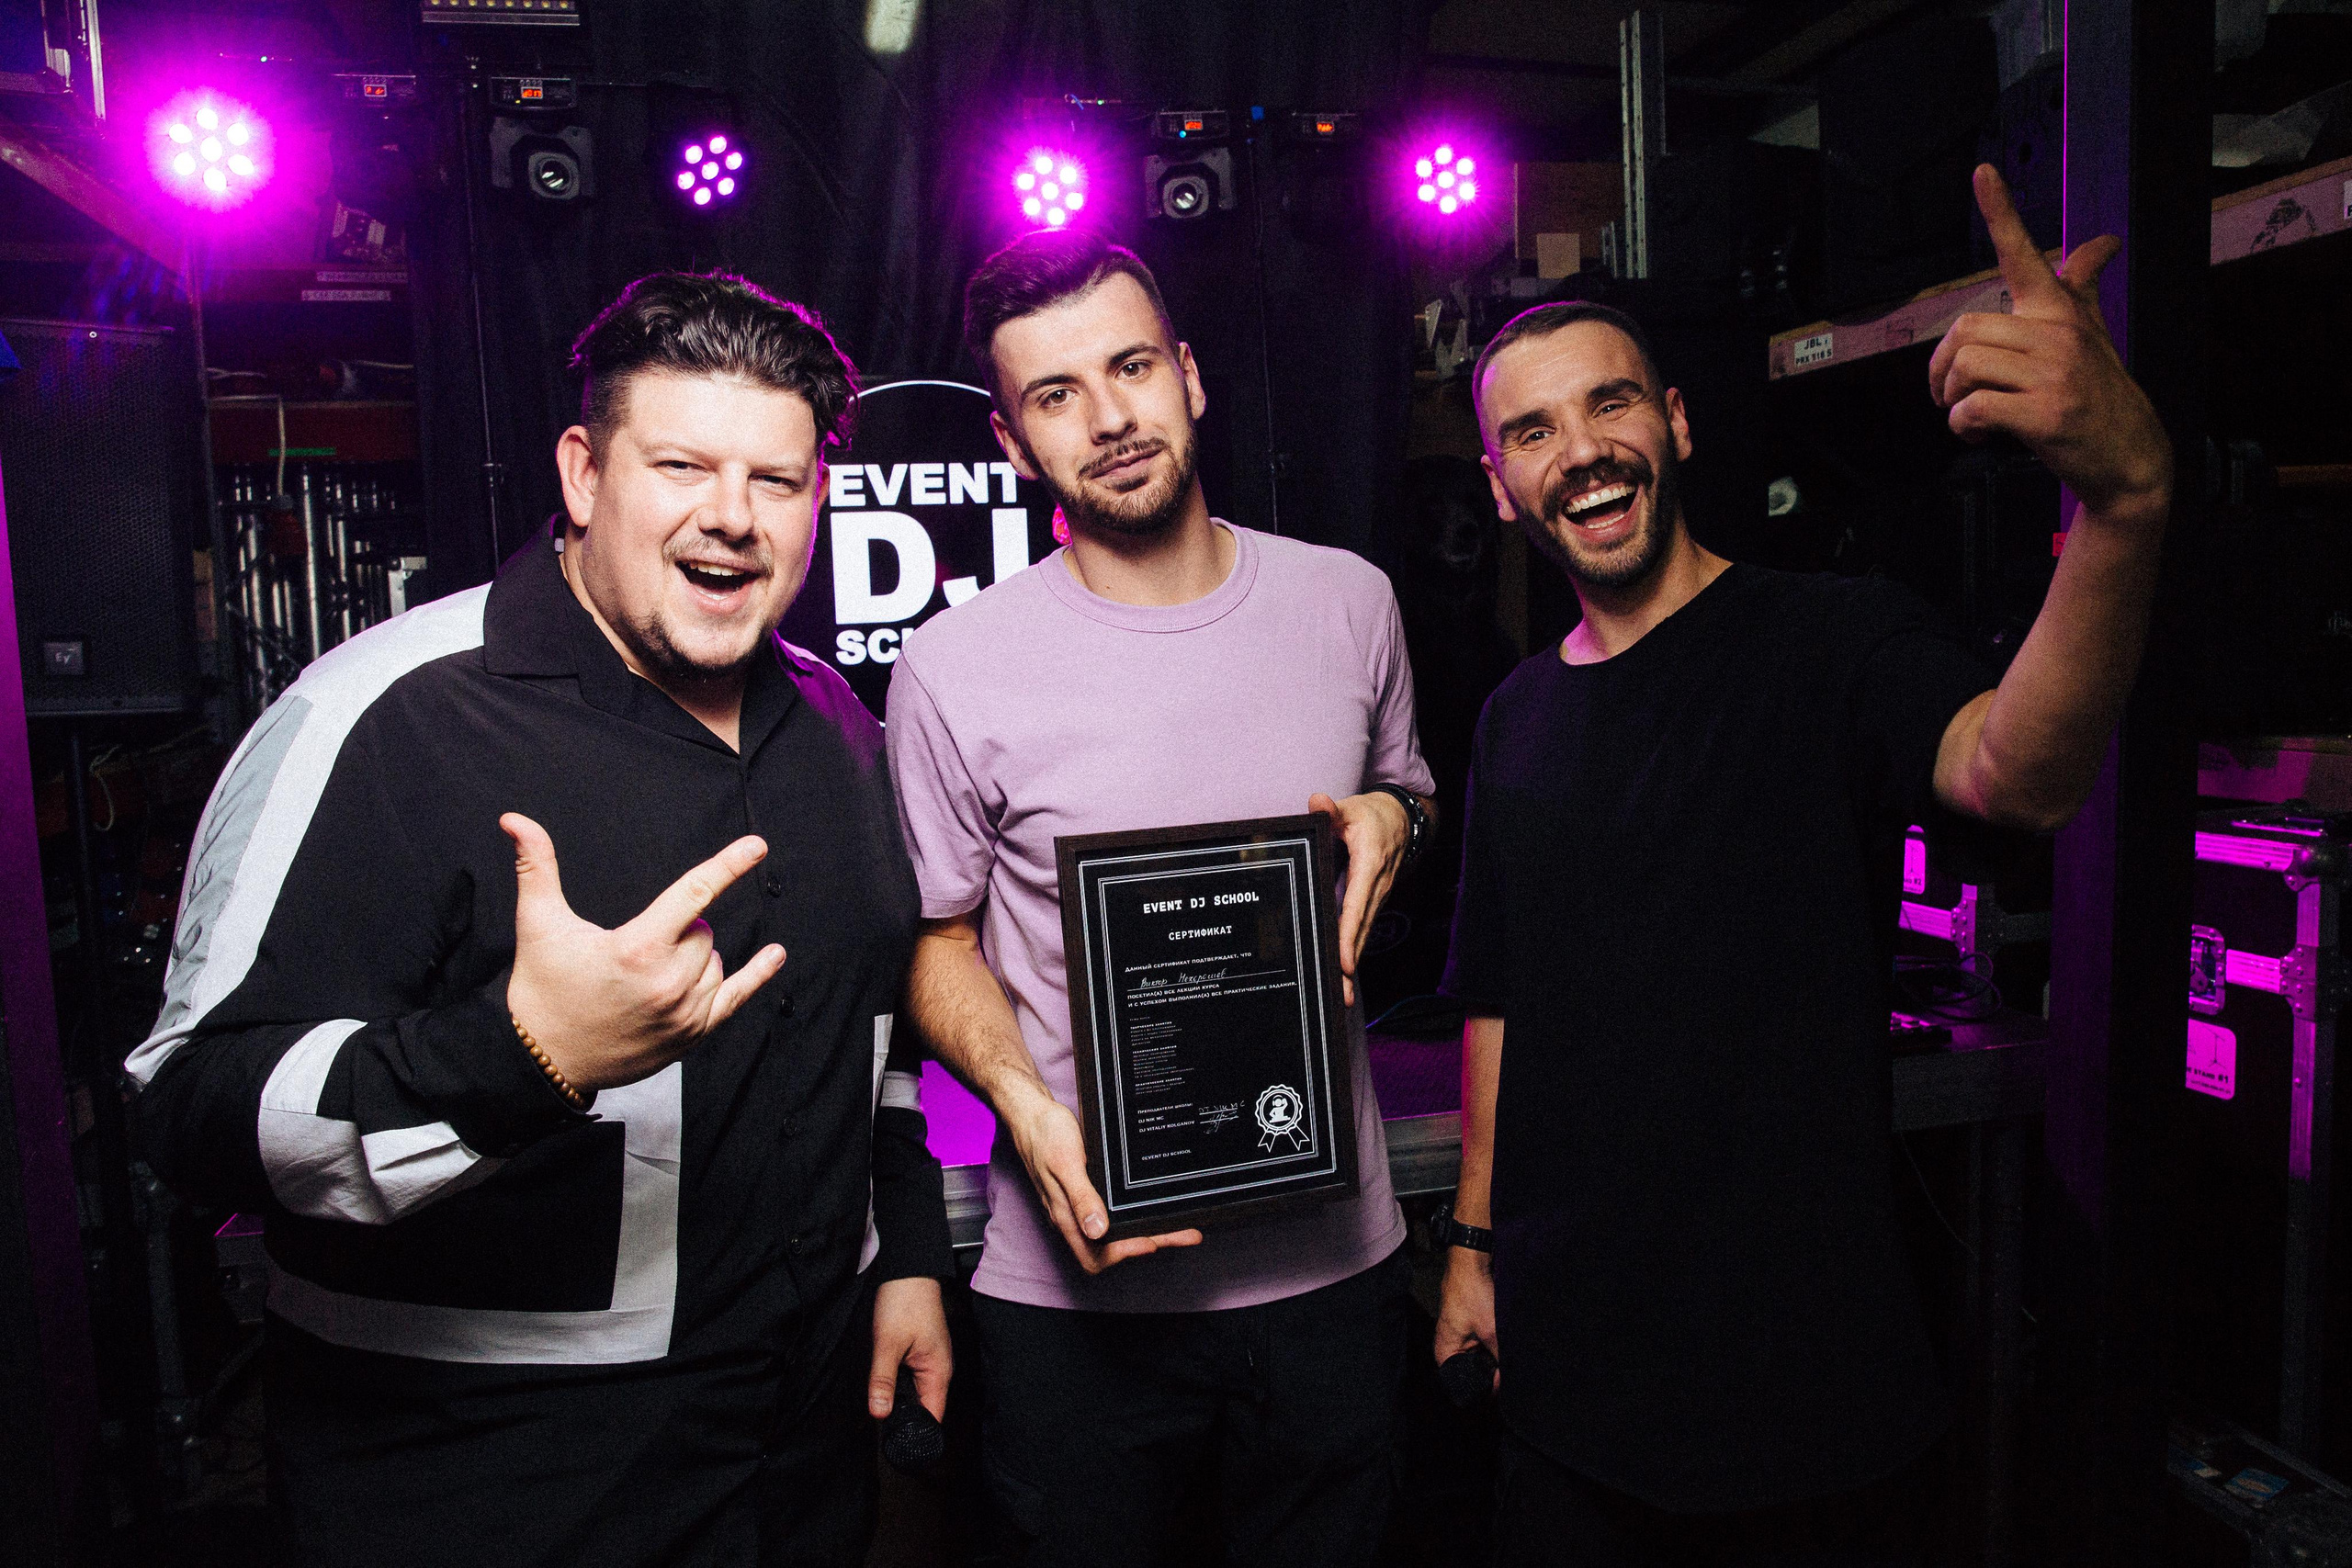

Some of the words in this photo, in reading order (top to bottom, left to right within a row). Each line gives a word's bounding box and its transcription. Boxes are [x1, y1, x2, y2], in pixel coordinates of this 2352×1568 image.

[1804, 337, 1822, 350] JBL
[829, 461, 1018, 507] EVENT
[830, 507, 1030, 626] DJ
[835, 627, 914, 666] SC
[1143, 899, 1182, 914] EVENT
[1190, 897, 1205, 908] DJ
[1214, 891, 1260, 906] SCHOOL
[1168, 925, 1232, 941] СЕРТИФИКАТ
[1125, 964, 1152, 973] ДАННЫЙ
[1153, 959, 1191, 968] СЕРТИФИКАТ
[1192, 953, 1239, 964] ПОДТВЕРЖДАЕТ,
[1140, 976, 1168, 988] Виктор
[1127, 990, 1162, 999] ПОСЕТИЛ(А)
[1139, 998, 1167, 1006] УСПЕХОМ
[1168, 993, 1210, 1002] ВЫПОЛНИЛ(А)
[1223, 986, 1267, 995] ПРАКТИЧЕСКИЕ
[1166, 1120, 1195, 1128] KOLGANOV
